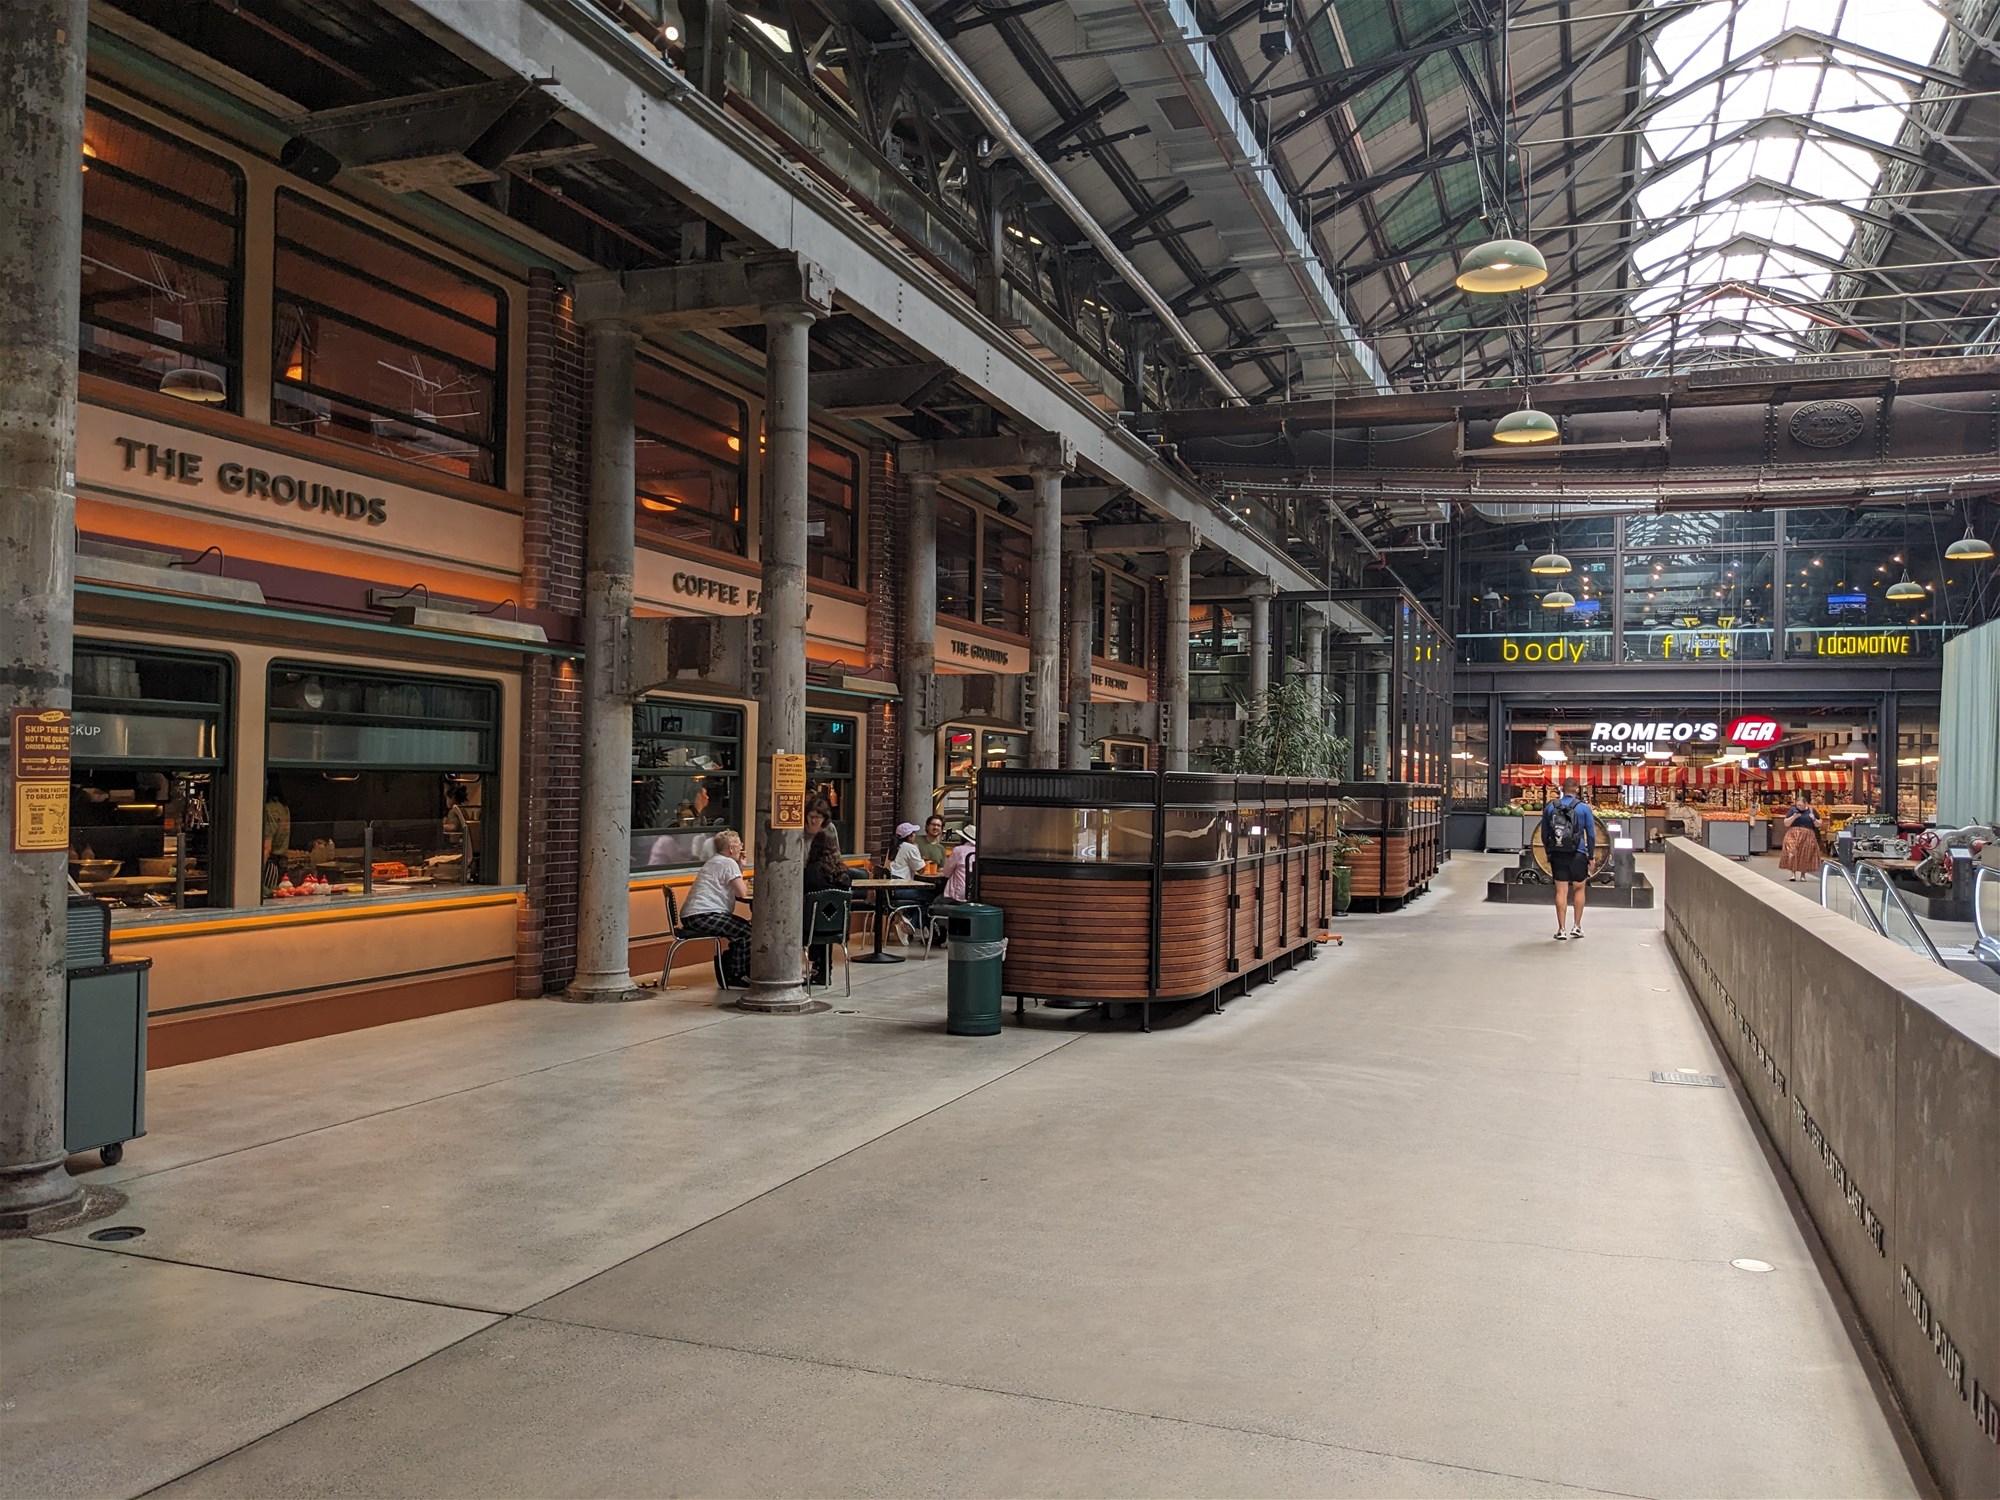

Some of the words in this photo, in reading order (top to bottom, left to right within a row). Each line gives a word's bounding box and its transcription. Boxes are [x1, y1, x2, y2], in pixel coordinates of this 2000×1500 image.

[1821, 415, 1848, 424] TONS
[115, 437, 203, 486] THE
[217, 462, 388, 526] GROUNDS
[673, 571, 740, 604] COFFEE
[951, 639, 970, 658] THE
[970, 643, 1009, 666] GROUNDS
[1503, 638, 1584, 663] body
[1818, 636, 1910, 655] LOCOMOTIVE
[24, 735, 39, 743] NOT
[40, 735, 51, 743] THE
[25, 725, 45, 733] SKIP
[46, 726, 59, 734] THE
[1591, 722, 1718, 741] ROMEO'S
[1732, 722, 1777, 741] IGA
[1590, 742, 1623, 753] Food
[1627, 742, 1653, 753] Hall
[1900, 1263, 1934, 1341] MOULD.
[1934, 1321, 1967, 1401] POUR.
